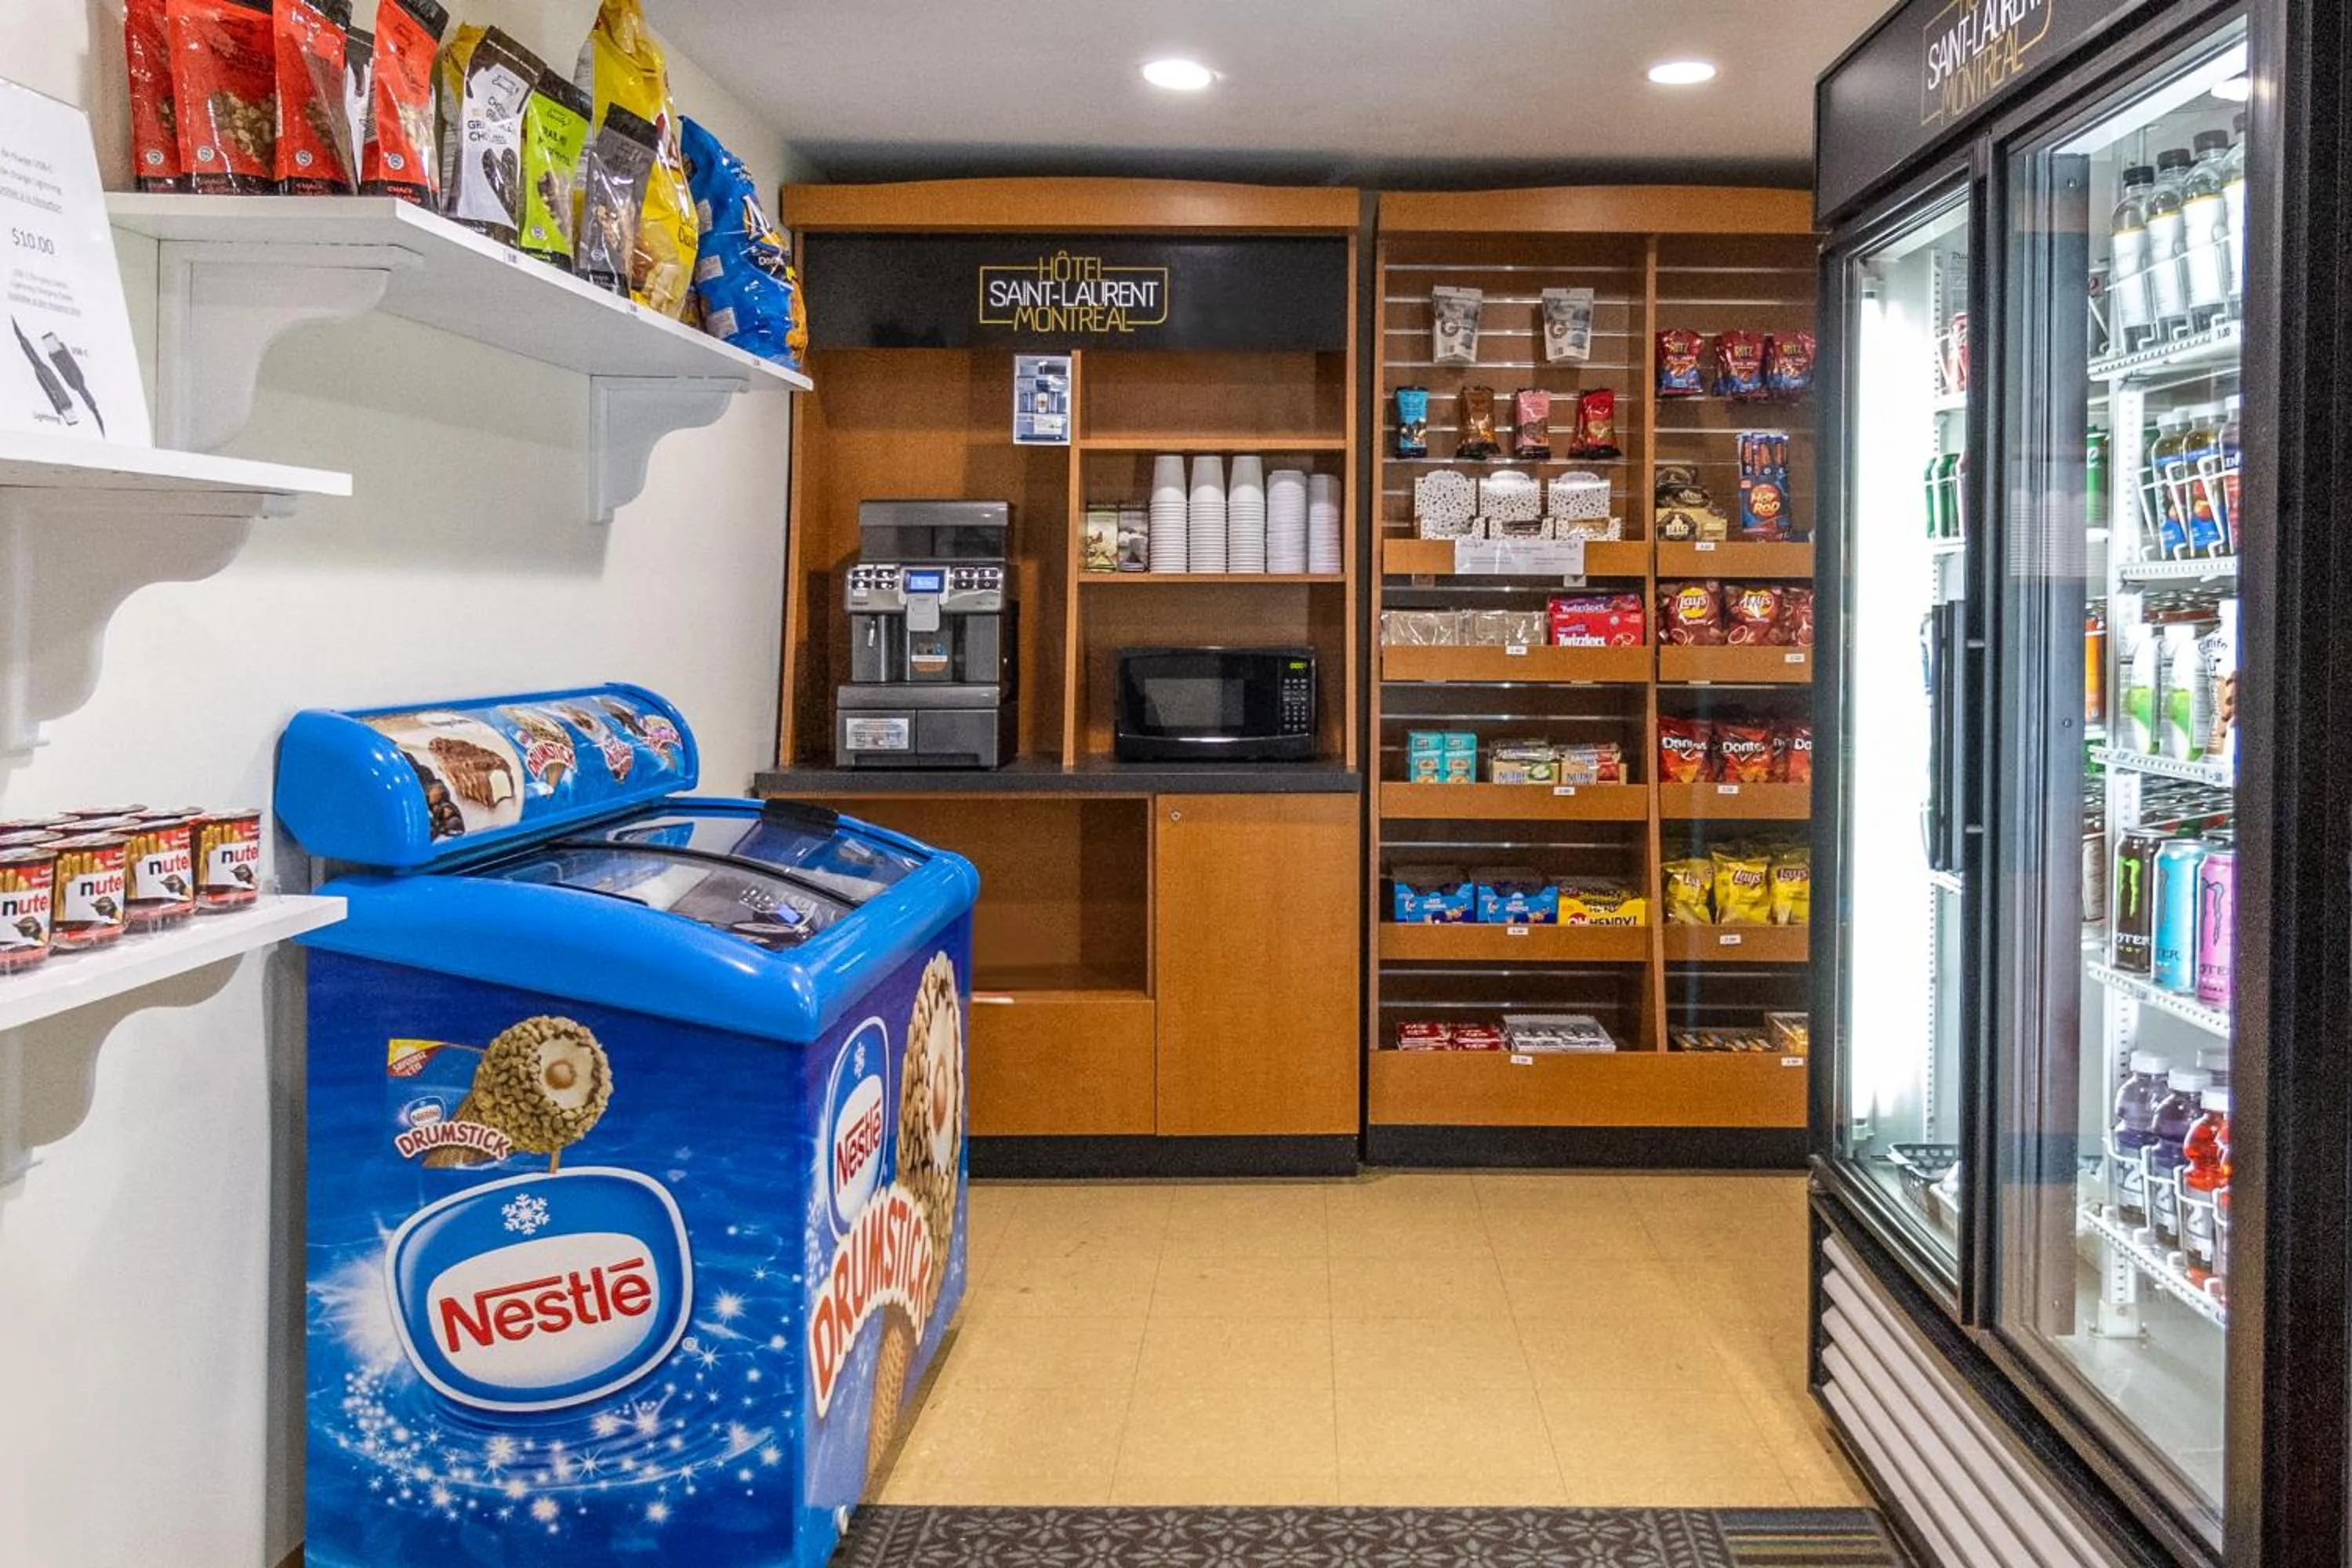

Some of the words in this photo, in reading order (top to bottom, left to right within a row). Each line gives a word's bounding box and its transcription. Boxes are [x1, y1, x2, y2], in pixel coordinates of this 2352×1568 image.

[1928, 0, 2042, 90] SAINT-LAURE
[12, 227, 55, 256] $10.00
[1038, 250, 1106, 282] HÔTEL
[989, 280, 1159, 307] SAINT-LAURENT
[149, 855, 189, 876] nute
[220, 845, 258, 864] nute
[80, 874, 123, 896] nute
[2, 894, 49, 916] nute
[397, 1123, 510, 1157] DRUMSTICK
[438, 1257, 652, 1352] Nestlé
[812, 1192, 931, 1401] DRUMSTICK
